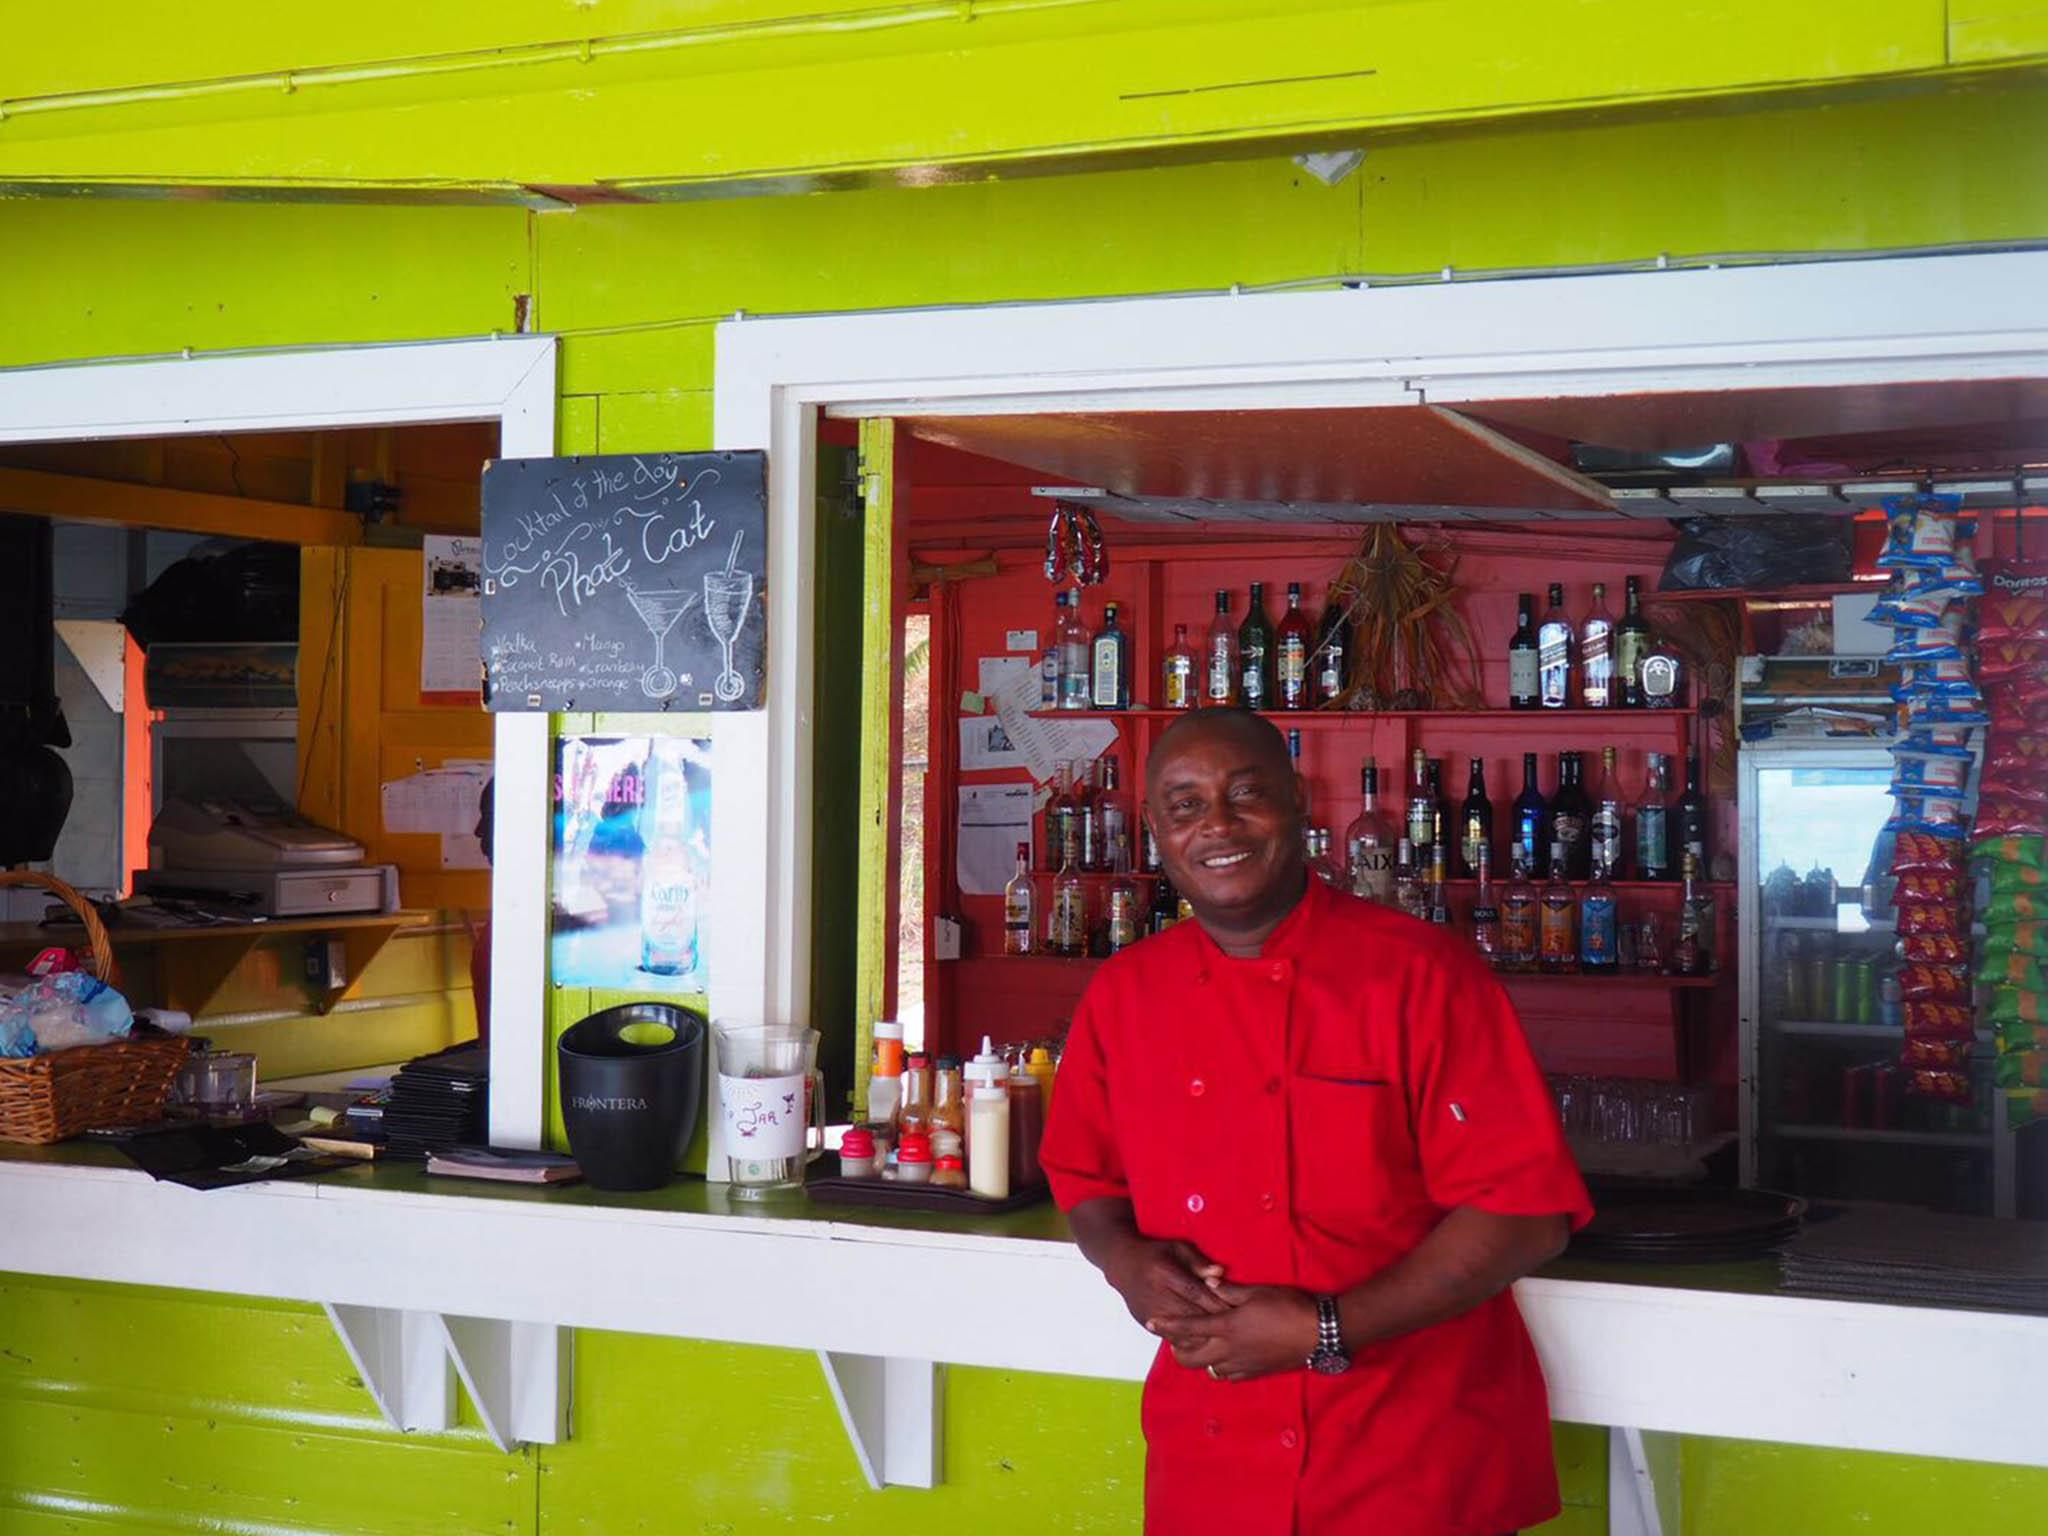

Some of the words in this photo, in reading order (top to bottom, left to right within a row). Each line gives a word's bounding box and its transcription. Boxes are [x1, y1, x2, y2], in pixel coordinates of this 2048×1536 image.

[483, 492, 573, 574] Cocktail
[592, 469, 631, 500] the
[633, 456, 679, 500] day
[540, 533, 631, 617] Phat
[642, 499, 717, 564] Cat
[496, 632, 537, 655] Vodka
[582, 632, 626, 658] Mango
[1361, 853, 1392, 870] AIX
[572, 1093, 648, 1112] FRONTERA
